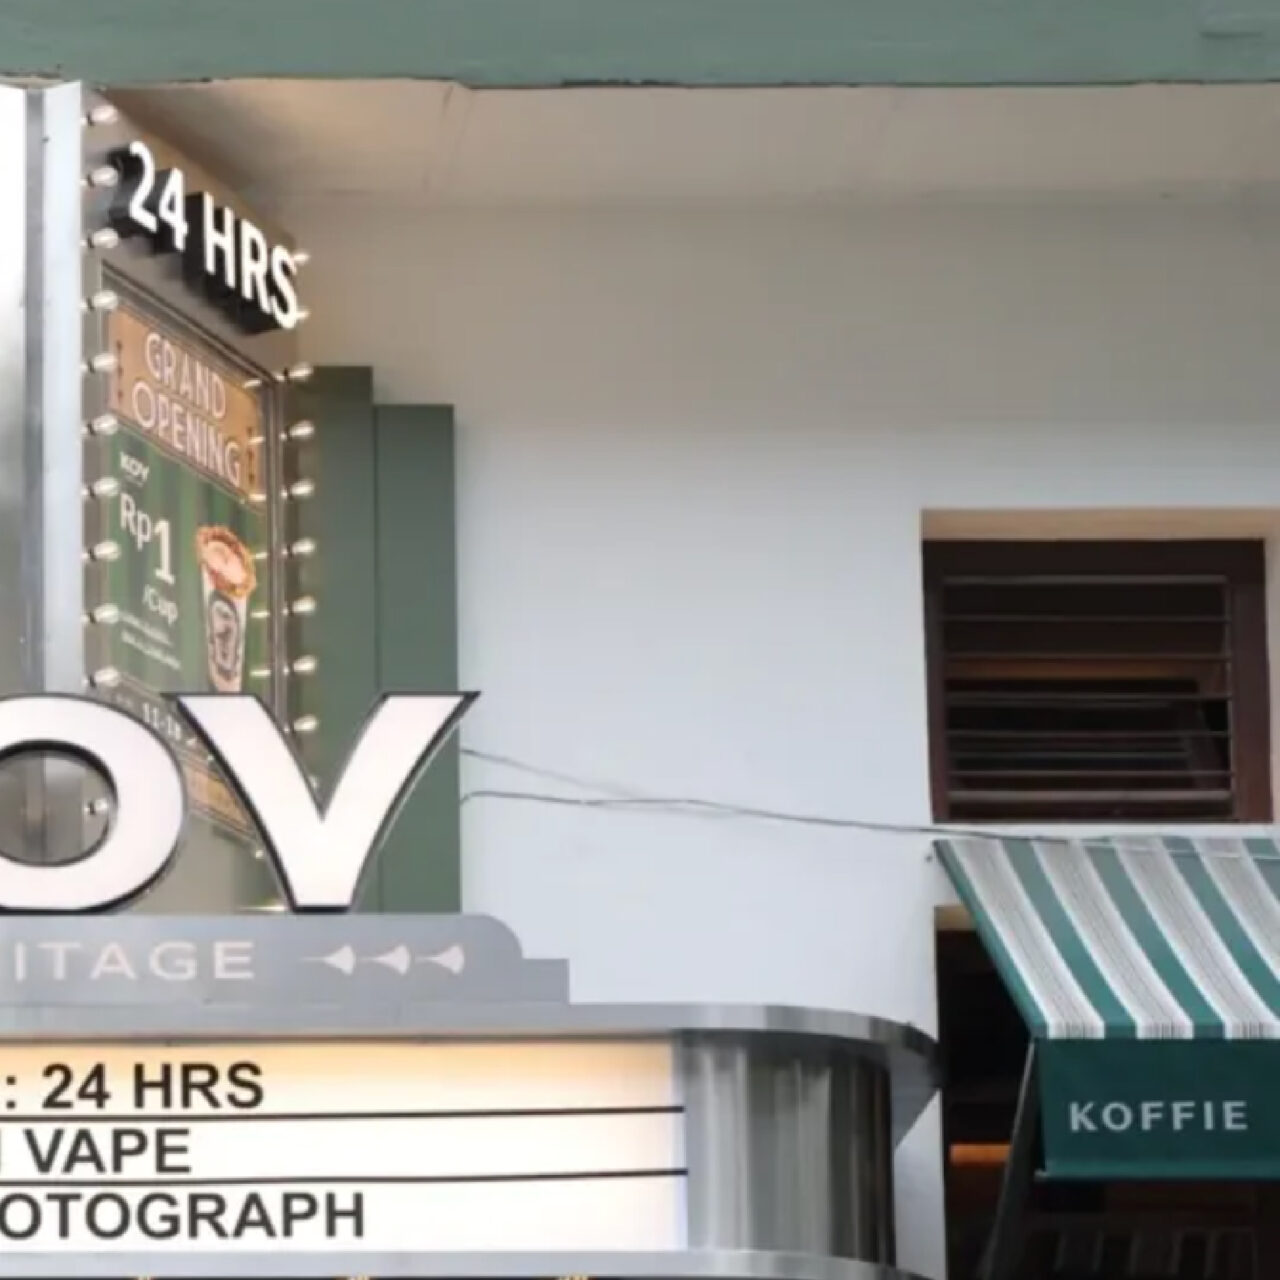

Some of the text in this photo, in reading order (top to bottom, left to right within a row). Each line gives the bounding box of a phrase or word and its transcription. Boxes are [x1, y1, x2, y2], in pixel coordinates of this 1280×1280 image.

[128, 141, 299, 329] 24 HRS
[145, 332, 227, 420] GRAND
[132, 385, 241, 487] OPENING
[41, 1063, 111, 1110] 24
[133, 1062, 265, 1109] HRS
[1070, 1101, 1248, 1132] KOFFIE
[23, 1128, 192, 1174] VAPE
